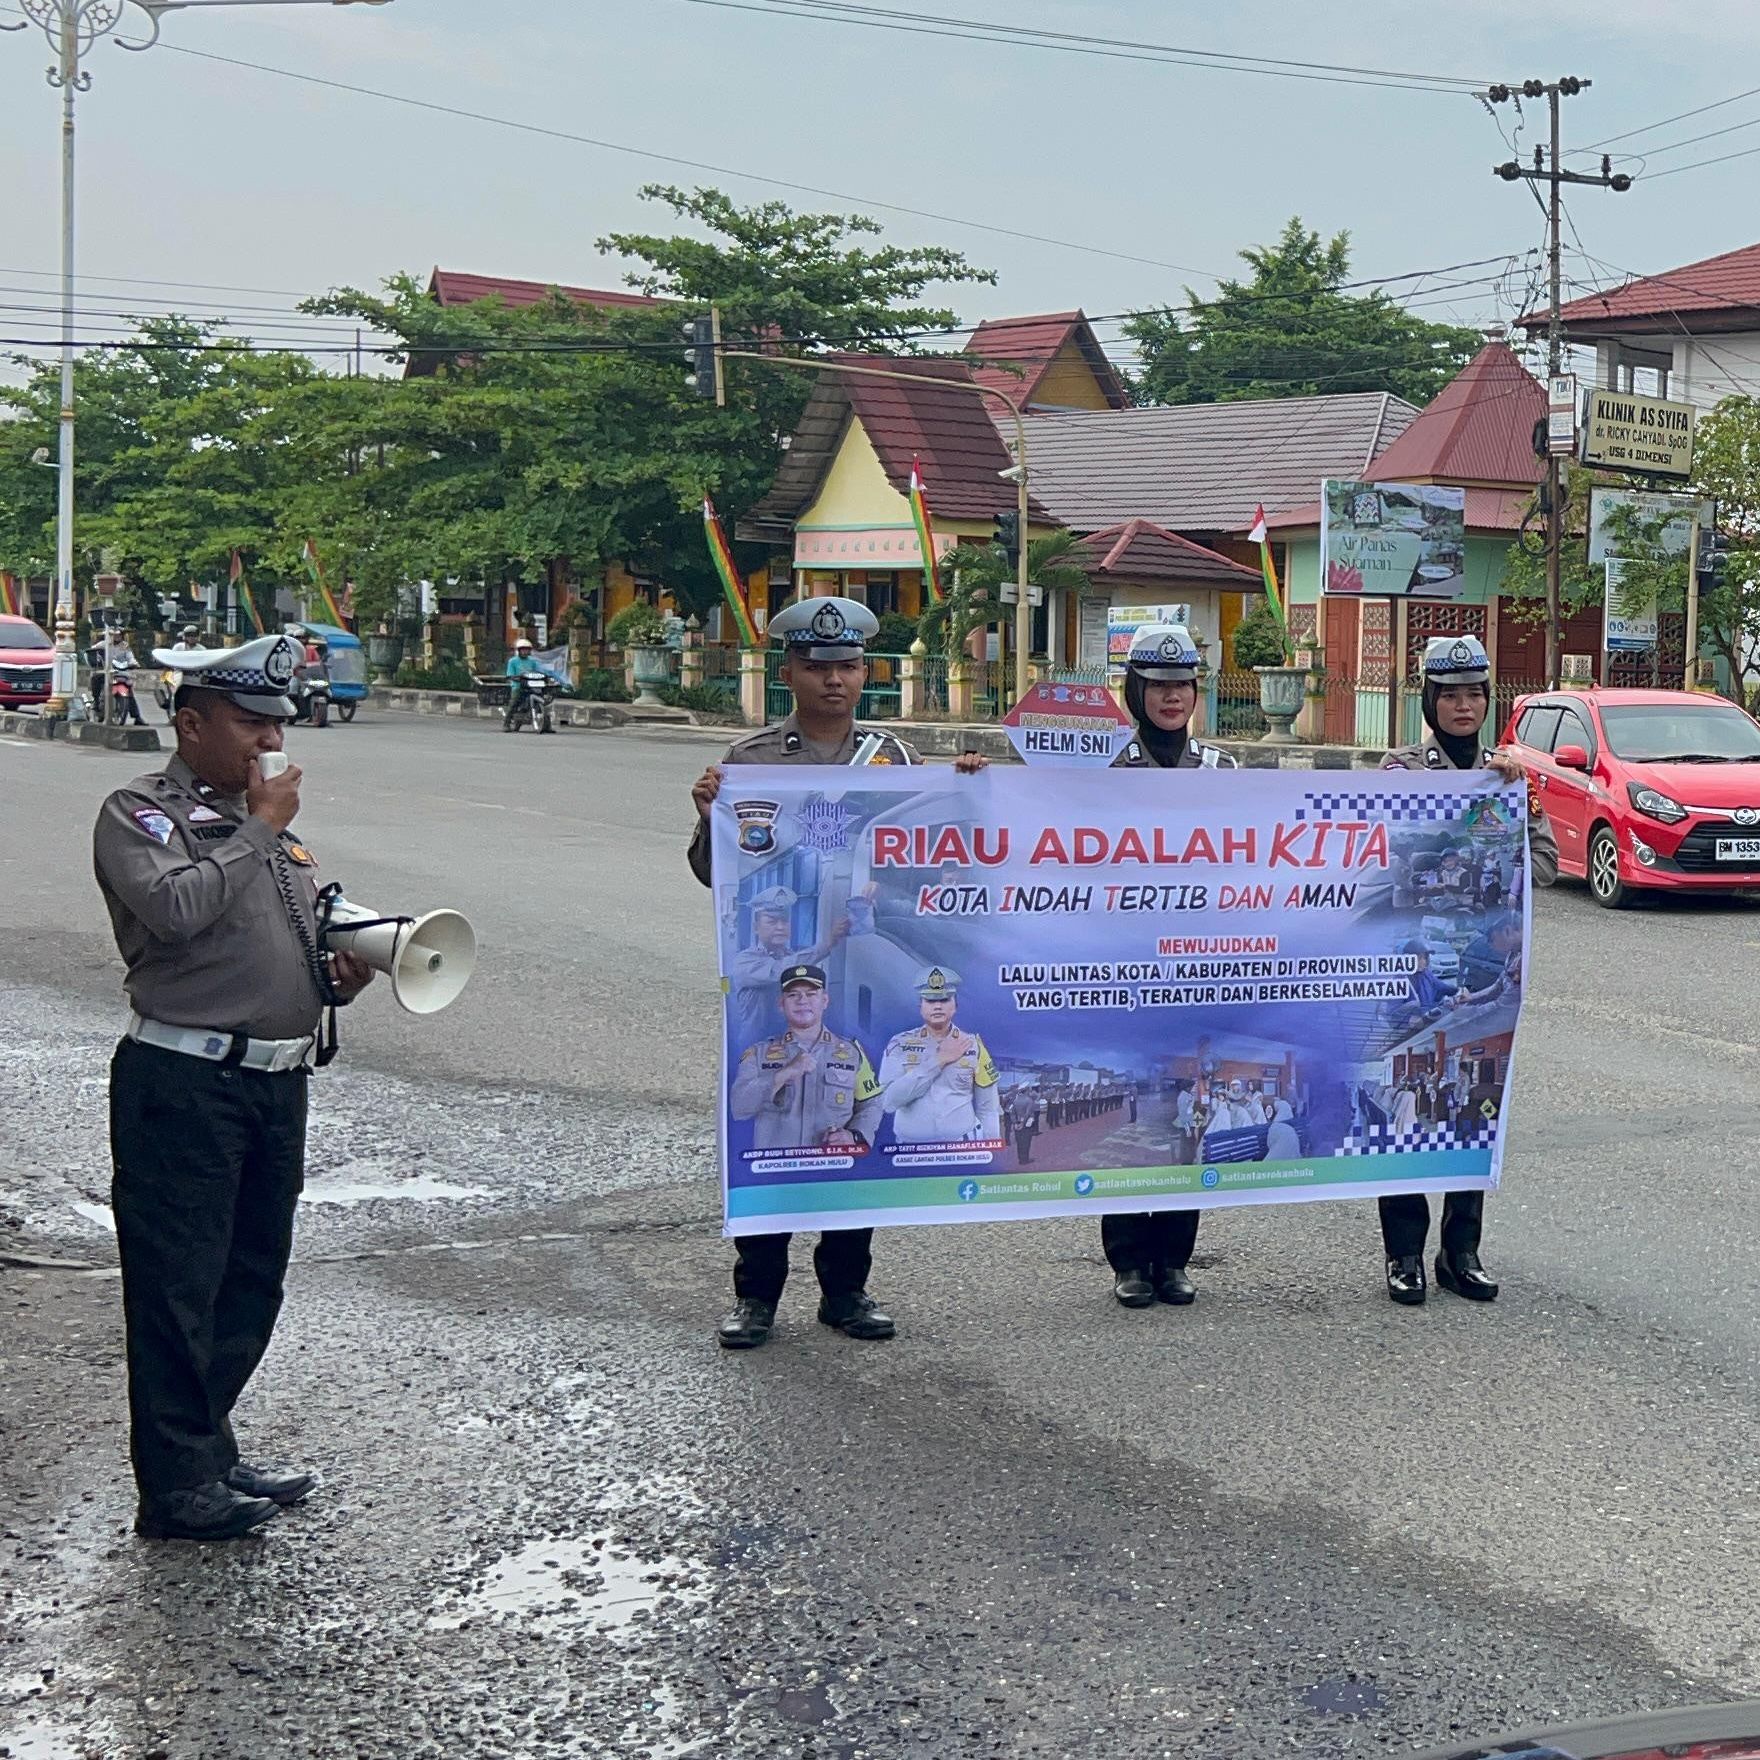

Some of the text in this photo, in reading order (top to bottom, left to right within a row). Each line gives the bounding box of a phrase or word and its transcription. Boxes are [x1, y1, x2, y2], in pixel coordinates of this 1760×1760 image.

[1597, 399, 1689, 431] KLINIK AS SYIFA
[1595, 426, 1605, 438] dr.
[1606, 426, 1631, 443] RICKY
[1668, 434, 1688, 453] SpOG
[1609, 445, 1672, 465] USG 4 DIMENSI
[1340, 536, 1398, 553] Air Panas
[1020, 714, 1117, 732] MENGGUNAKAN
[1025, 730, 1111, 755] HELM SNI
[873, 821, 1390, 868] RIAU ADALAH KITA
[1719, 841, 1732, 853] BM
[1735, 841, 1760, 853] 1353
[919, 883, 1358, 912] KOTA INDAH TERTIB DAN AMAN
[1158, 936, 1277, 955] MEWUJUDKAN
[1001, 966, 1046, 983] LALU
[1051, 965, 1111, 982] LINTAS
[1117, 963, 1162, 981] KOTA
[1175, 961, 1272, 979] KABUPATEN
[1277, 960, 1293, 976] DI
[1298, 957, 1372, 975] PROVINSI
[1378, 956, 1416, 973] RIAU
[1016, 982, 1407, 1008] YANG TERTIB, TERATUR DAN BERKESELAMATAN
[758, 1161, 798, 1170] KAPOLRES
[799, 1159, 826, 1168] ROKAN
[1094, 1174, 1192, 1189] satlantasrokanhulu
[1221, 1167, 1314, 1182] satlantasrokanhulu
[980, 1180, 1062, 1195] Satlantas Rohul
